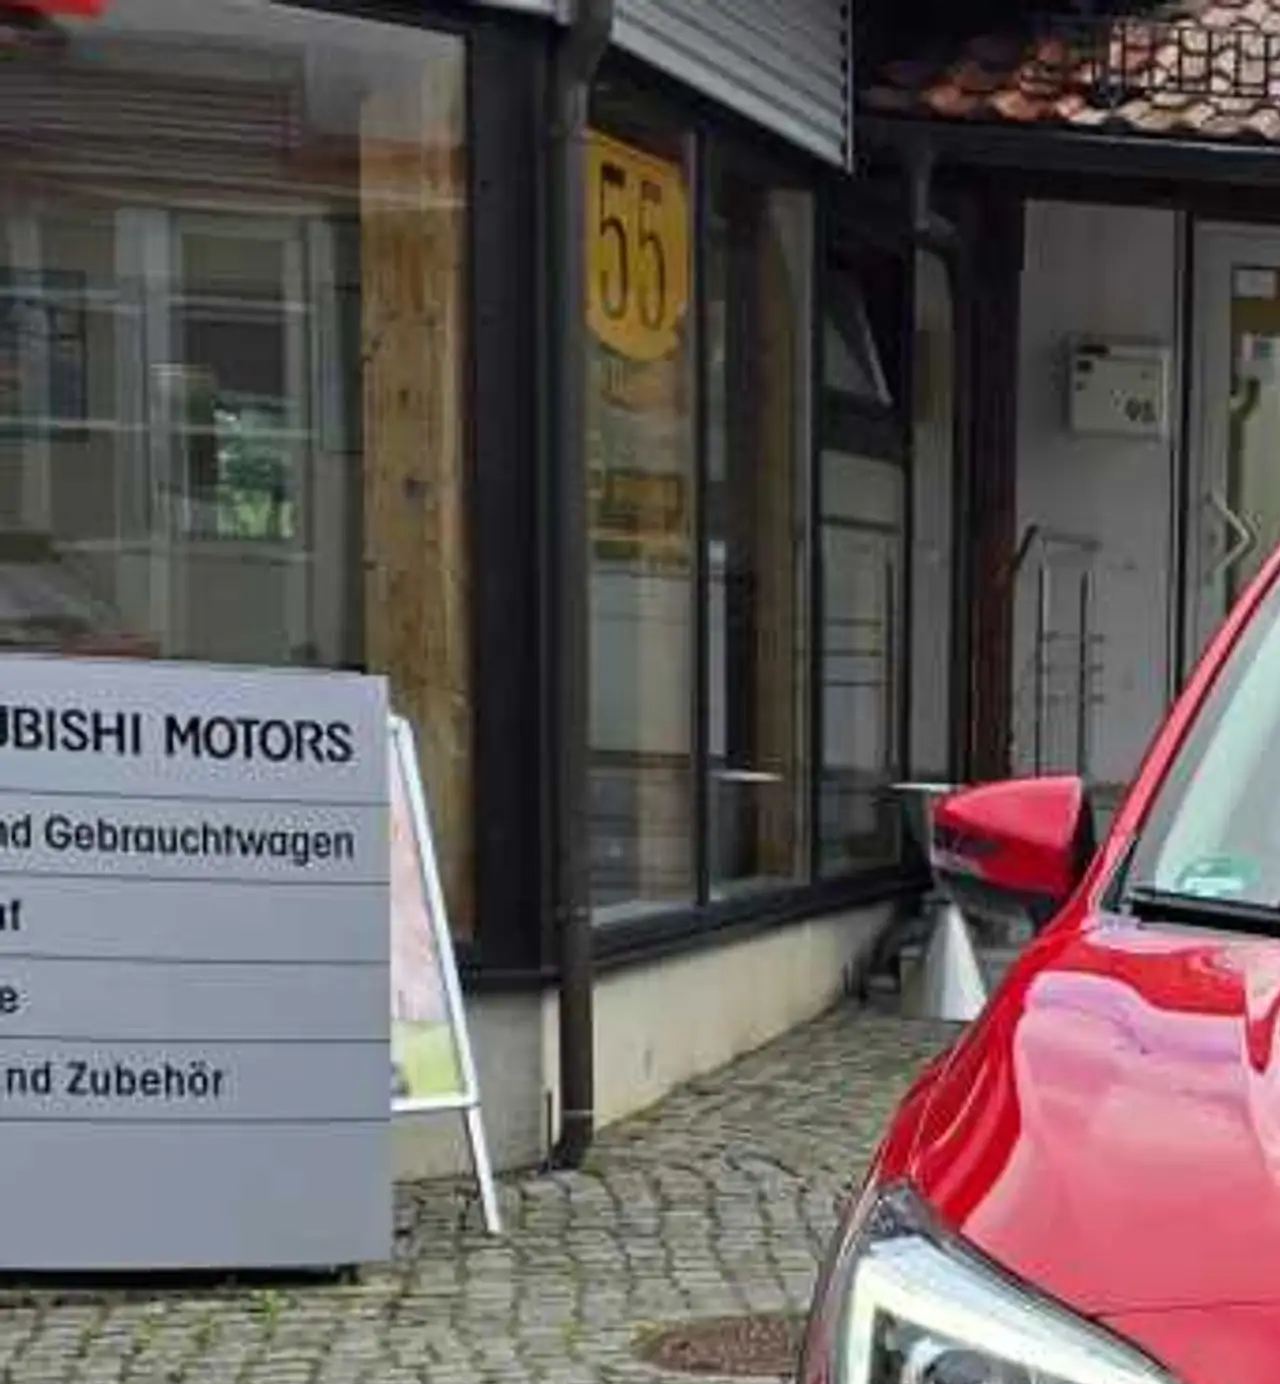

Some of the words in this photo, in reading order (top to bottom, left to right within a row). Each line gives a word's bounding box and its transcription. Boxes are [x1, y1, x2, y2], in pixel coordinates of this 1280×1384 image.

[600, 160, 667, 332] 55
[164, 713, 354, 763] MOTORS
[44, 814, 355, 867] Gebrauchtwagen
[6, 1061, 51, 1098] nd
[66, 1060, 223, 1099] Zubehör
